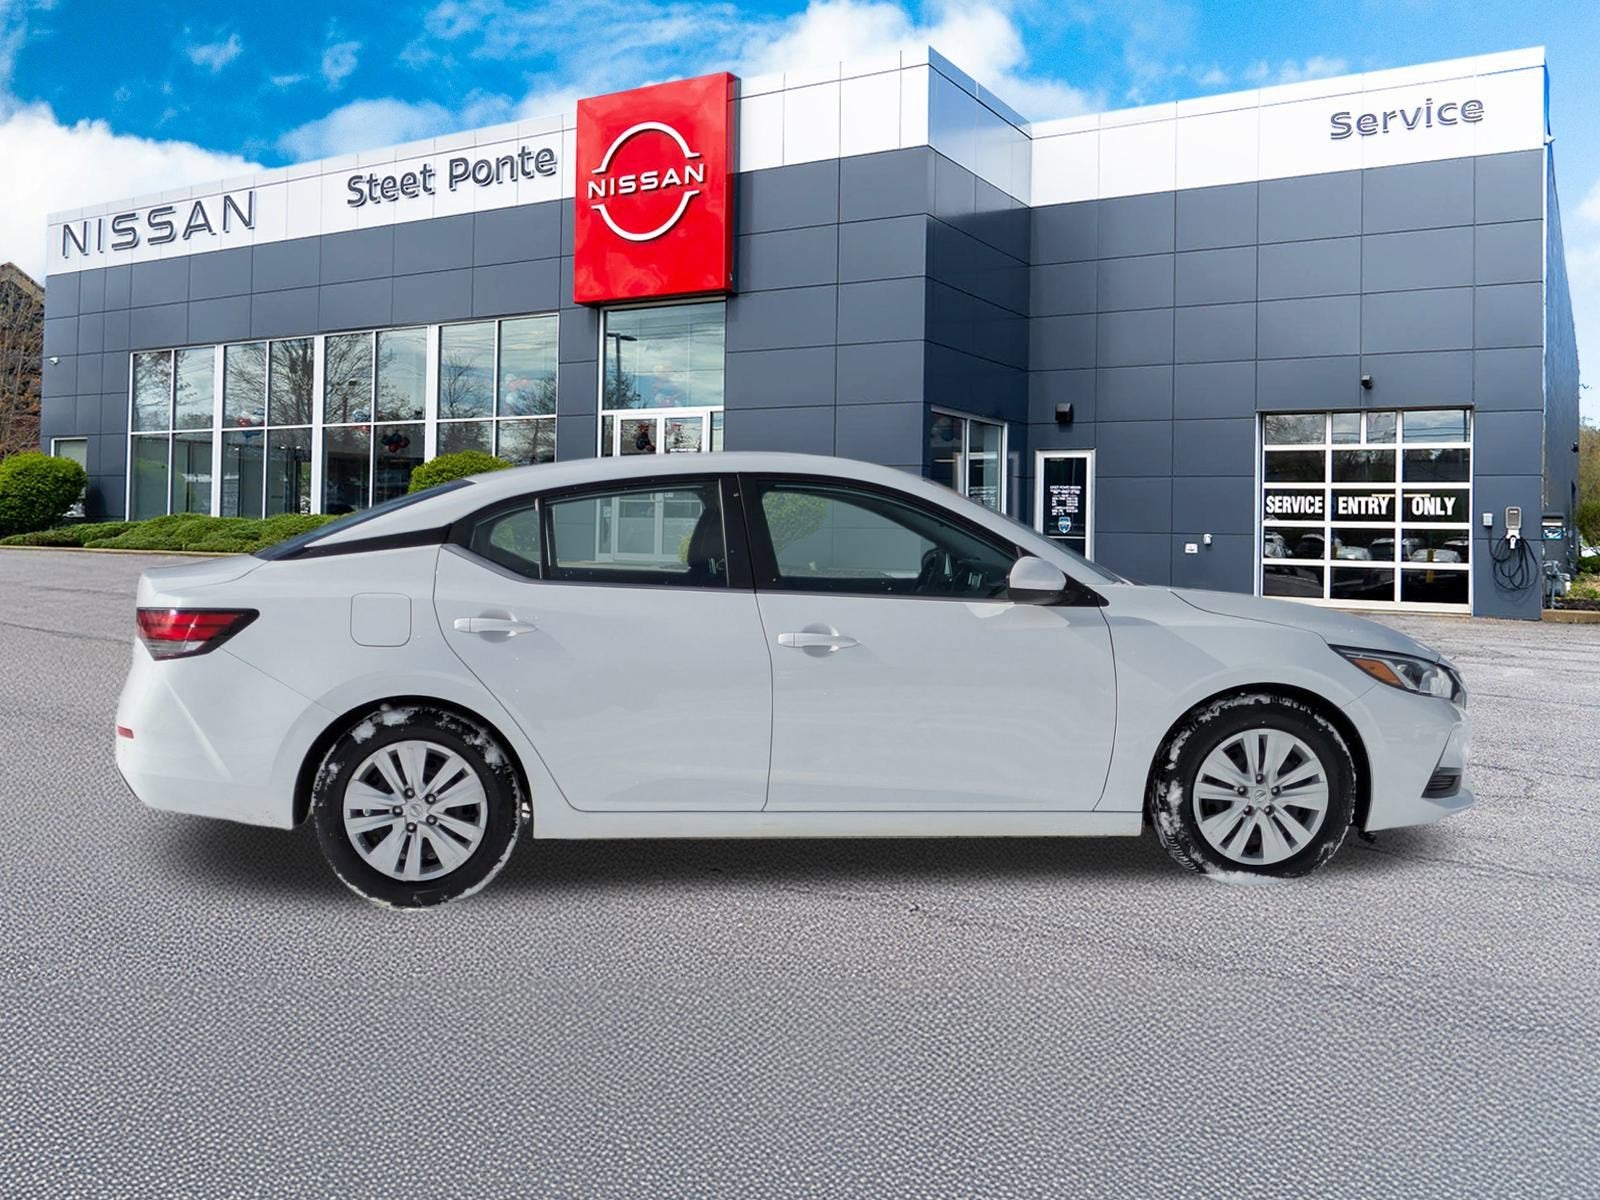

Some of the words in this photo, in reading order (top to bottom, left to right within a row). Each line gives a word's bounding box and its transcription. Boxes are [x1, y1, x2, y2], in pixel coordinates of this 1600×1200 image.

[1330, 97, 1484, 140] Service
[347, 164, 435, 207] Steet
[449, 145, 556, 191] Ponte
[587, 163, 705, 198] NISSAN
[62, 191, 255, 259] NISSAN
[1265, 495, 1323, 514] SERVICE
[1338, 496, 1389, 515] ENTRY
[1412, 497, 1456, 515] ONLY
